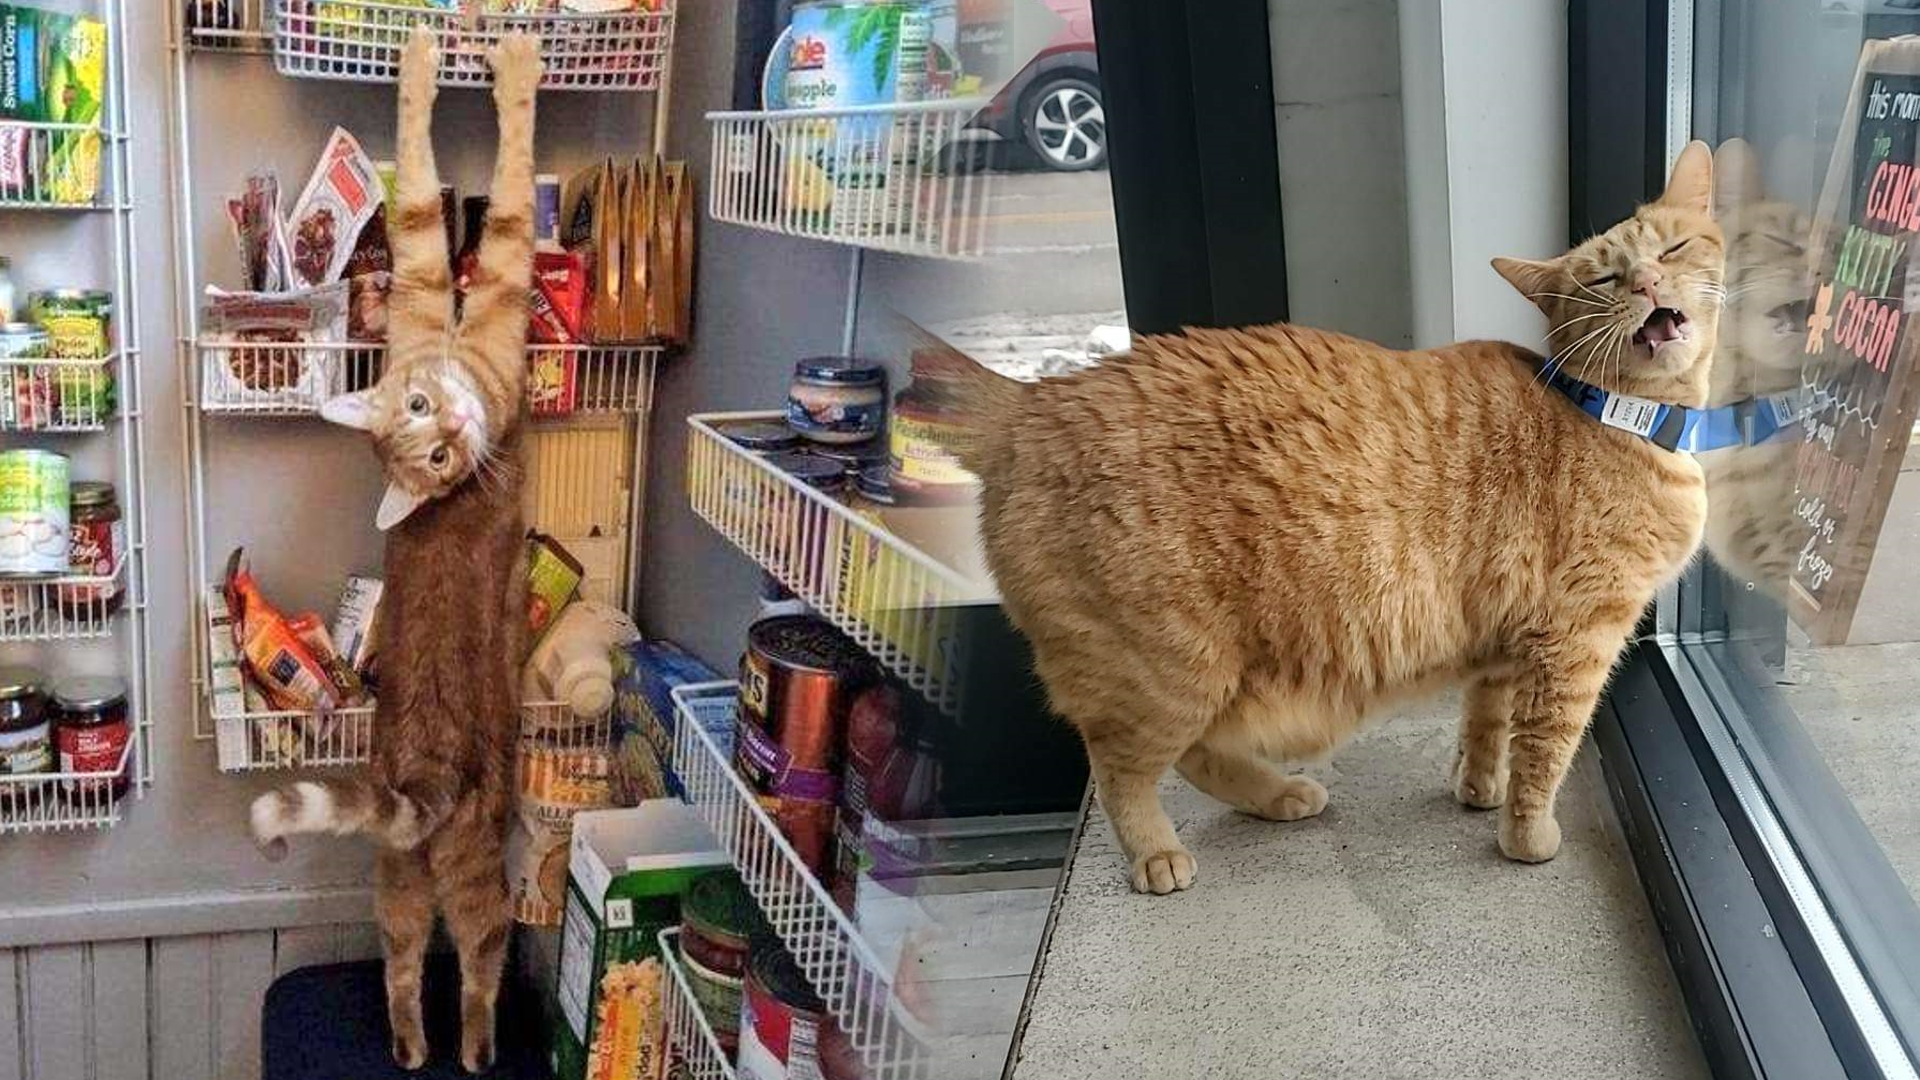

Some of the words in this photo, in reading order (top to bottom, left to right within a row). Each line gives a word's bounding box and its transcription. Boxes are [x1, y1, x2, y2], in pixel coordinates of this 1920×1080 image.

[3, 14, 17, 58] Corn
[3, 59, 17, 109] Sweet
[1835, 224, 1907, 299] KITTY
[1834, 290, 1900, 373] COCOA
